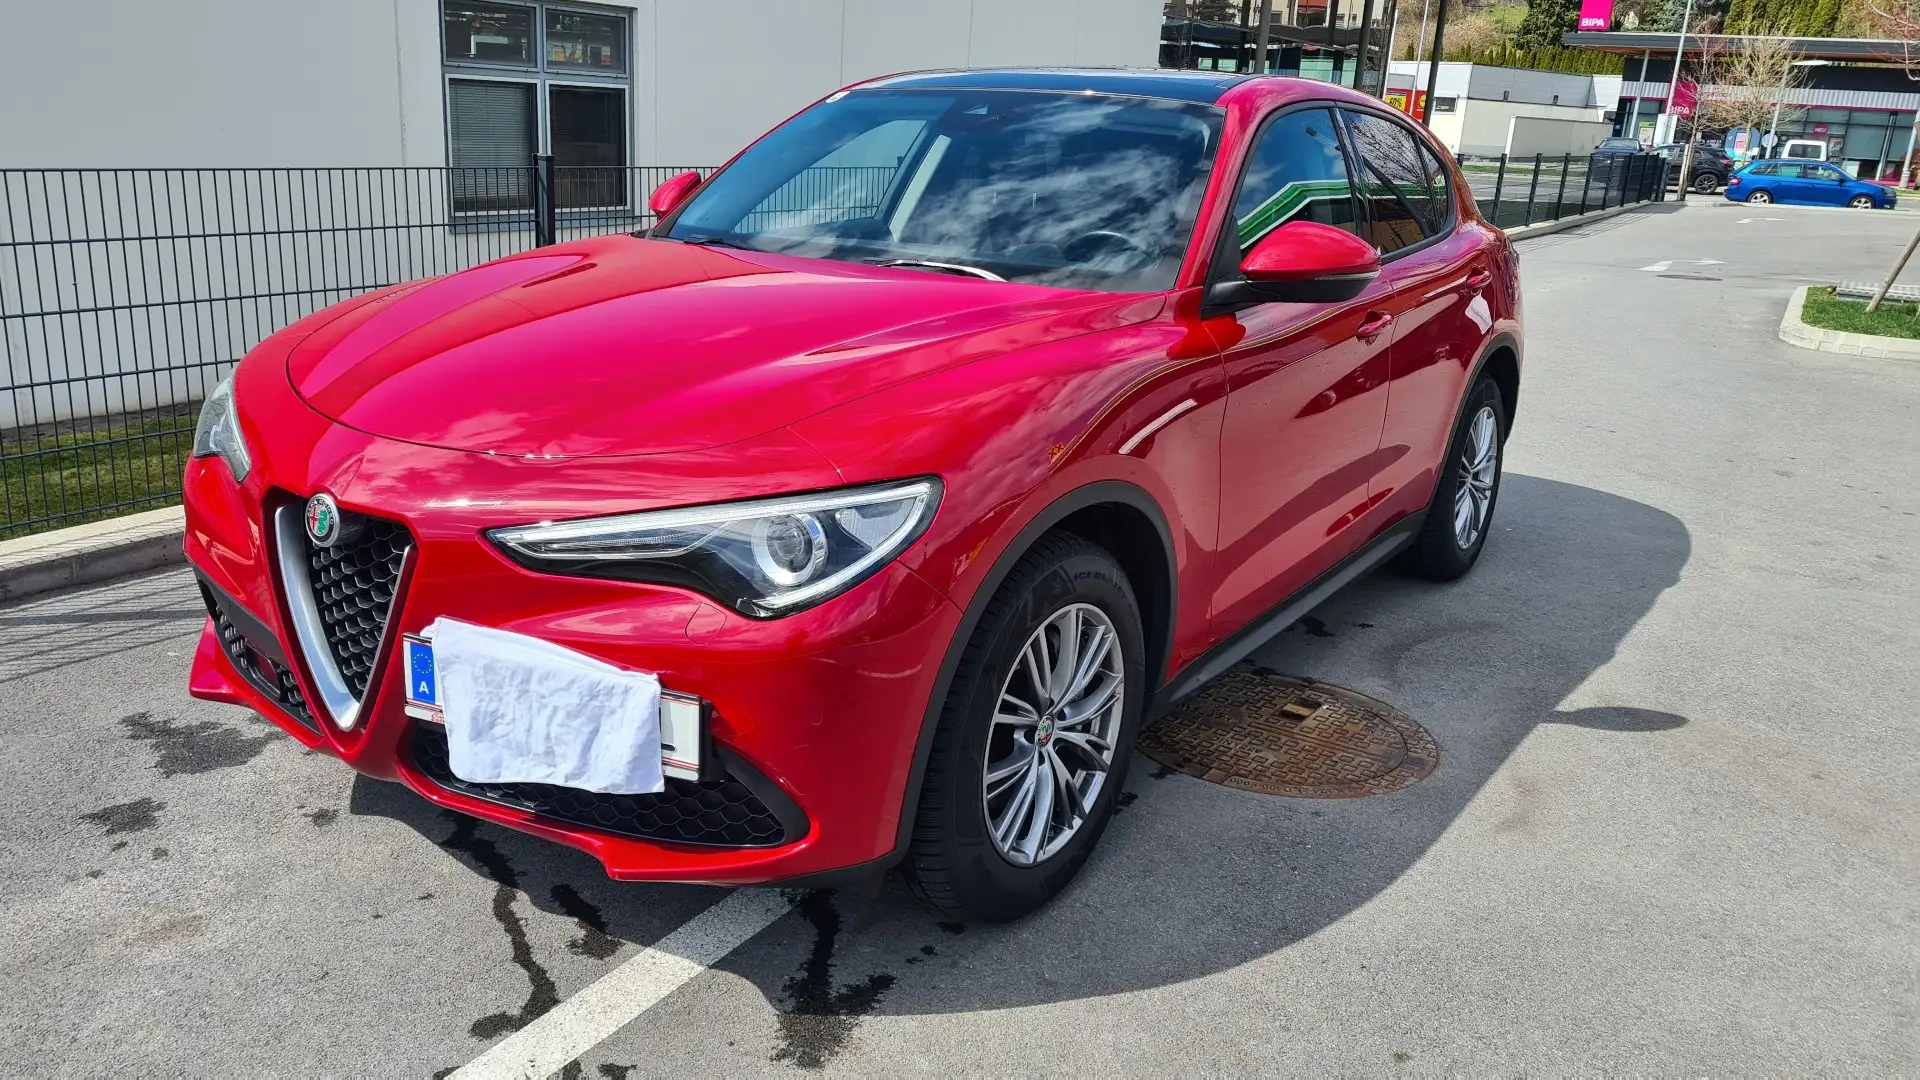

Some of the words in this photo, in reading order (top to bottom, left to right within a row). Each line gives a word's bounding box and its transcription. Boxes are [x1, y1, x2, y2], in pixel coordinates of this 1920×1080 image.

[1581, 17, 1604, 27] BIPA
[1668, 106, 1690, 115] BIPA
[418, 680, 430, 695] A
